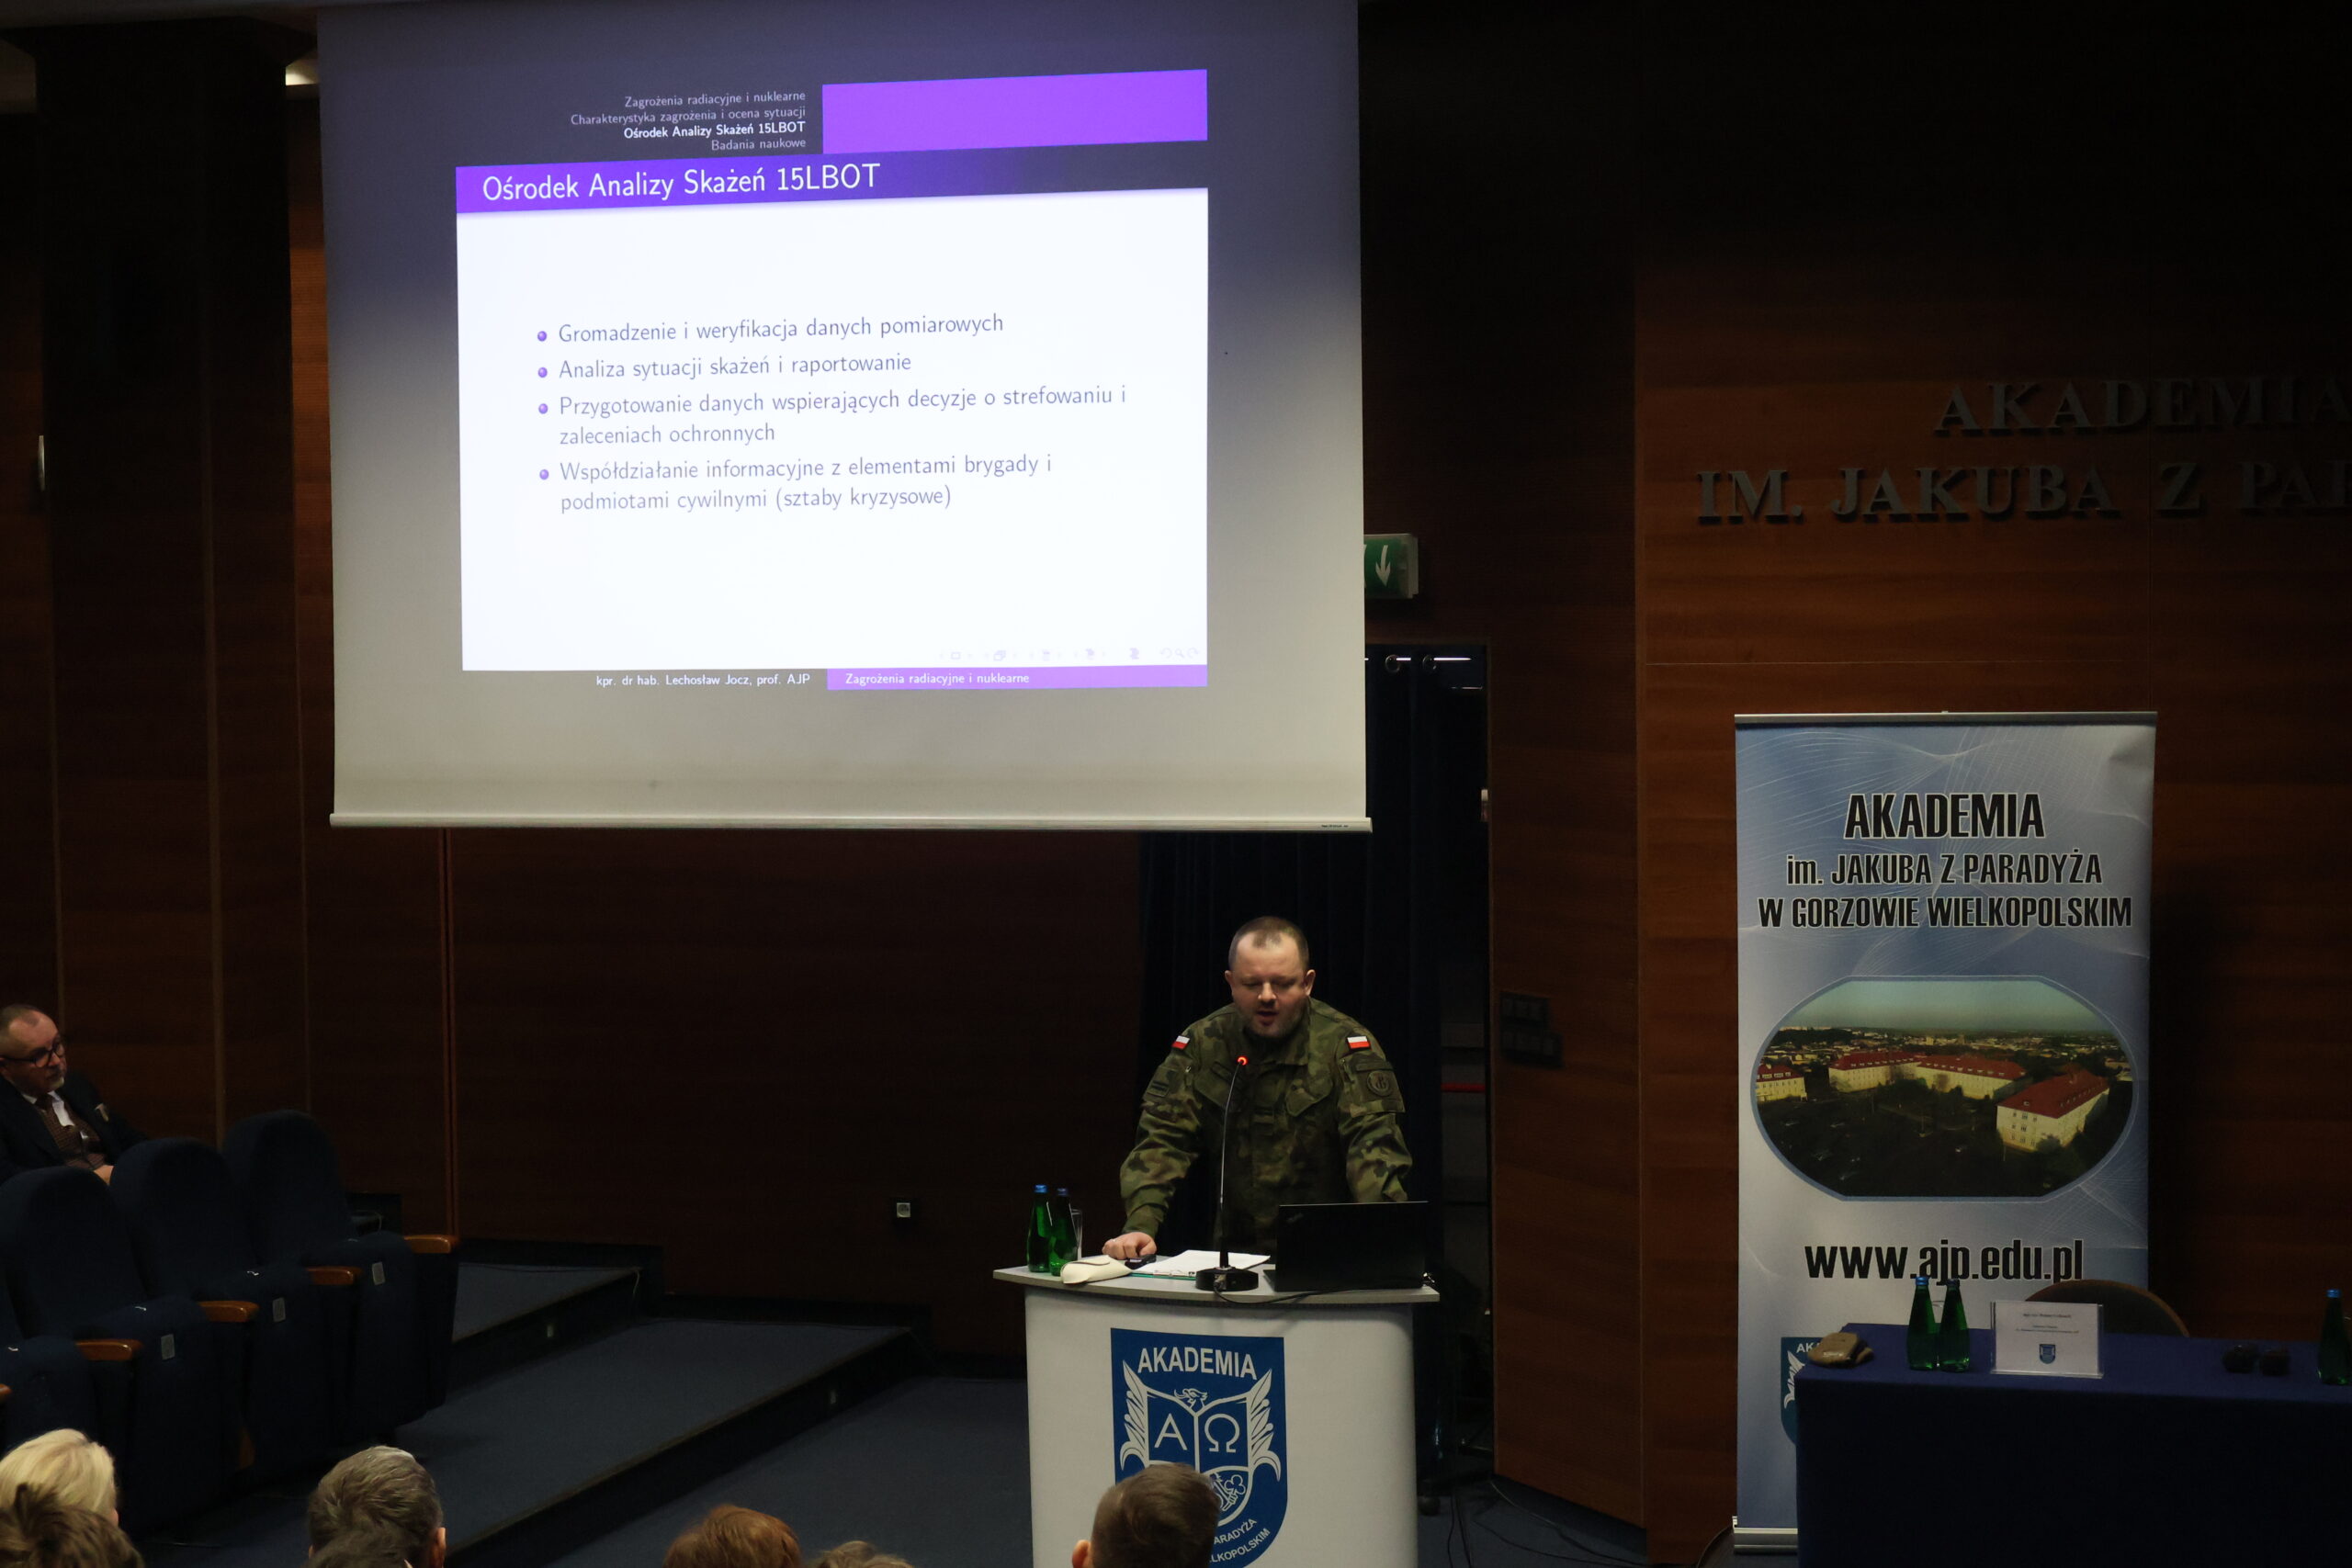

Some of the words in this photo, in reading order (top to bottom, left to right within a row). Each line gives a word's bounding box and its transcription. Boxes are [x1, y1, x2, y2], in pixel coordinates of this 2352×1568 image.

[625, 96, 683, 109] Zagrożenia
[688, 94, 742, 107] radiacyjne
[753, 91, 806, 103] nuklearne
[571, 113, 656, 126] Charakterystyka
[660, 110, 717, 124] zagrożenia
[728, 110, 760, 119] ocena
[763, 106, 806, 120] sytuacji
[624, 127, 669, 139] Ośrodek
[673, 125, 712, 139] Analizy
[716, 123, 754, 136] Skażeń
[758, 121, 806, 134] 15LBOT
[711, 140, 755, 151] Badania
[760, 138, 806, 150] naukowe
[482, 174, 579, 201] Ośrodek
[589, 171, 673, 201] Analizy
[684, 167, 765, 194] Skażeń
[777, 163, 881, 191] 15LBOT
[559, 322, 676, 343] Gromadzenie
[684, 321, 688, 339] i
[696, 319, 797, 344] weryfikacja
[807, 318, 872, 341] danych
[880, 312, 1003, 339] pomiarowych
[559, 359, 625, 378] Analiza
[633, 357, 702, 381] sytuacji
[710, 355, 770, 376] skażeń
[779, 355, 783, 373] i
[792, 353, 911, 377] raportowanie
[560, 395, 692, 419] Przygotowanie
[699, 392, 763, 416] danych
[773, 389, 899, 413] wspierających
[908, 388, 977, 411] decyzje
[984, 393, 996, 405] o
[1003, 385, 1112, 405] strefowaniu
[1122, 385, 1125, 402] i
[1934, 374, 2352, 436] AKADEMIA
[560, 424, 662, 445] zaleceniach
[669, 423, 775, 446] ochronnych
[560, 460, 698, 484] Współdziałanie
[707, 458, 824, 480] informacyjne
[831, 463, 841, 476] z
[849, 456, 956, 476] elementami
[965, 454, 1038, 478] brygady
[1047, 454, 1051, 471] i
[561, 491, 669, 514] podmiotami
[677, 490, 767, 513] cywilnymi
[776, 487, 842, 513] (sztaby
[851, 484, 951, 510] kryzysowe)
[1696, 468, 1804, 523] IM.
[1829, 462, 2121, 520] JAKUBA
[2154, 462, 2207, 517] Z
[595, 675, 616, 688] kpr.
[622, 674, 633, 686] dr
[638, 674, 660, 686] hab.
[666, 673, 721, 686] Lechosław
[725, 673, 752, 687] Jocz,
[756, 673, 782, 688] prof.
[786, 673, 810, 684] AJP
[845, 672, 905, 686] Zagrożenia
[909, 671, 966, 686] radiacyjne
[977, 671, 1030, 683] nuklearne
[1843, 792, 2044, 840] AKADEMIA
[1787, 854, 1824, 886] im.
[1831, 854, 1932, 886] JAKUBA
[1939, 854, 1956, 885] Z
[1963, 848, 2102, 885] PARADYŻA
[1758, 897, 1784, 928] W
[1792, 897, 1918, 928] GORZOWIE
[1927, 897, 2132, 928] WIELKOPOLSKIM
[1804, 1239, 2084, 1285] www.ajp.edu.pl
[1137, 1347, 1257, 1381] AKADEMIA
[1210, 1528, 1271, 1562] LKOPOLSKIM
[1214, 1518, 1257, 1544] ARADYŻA
